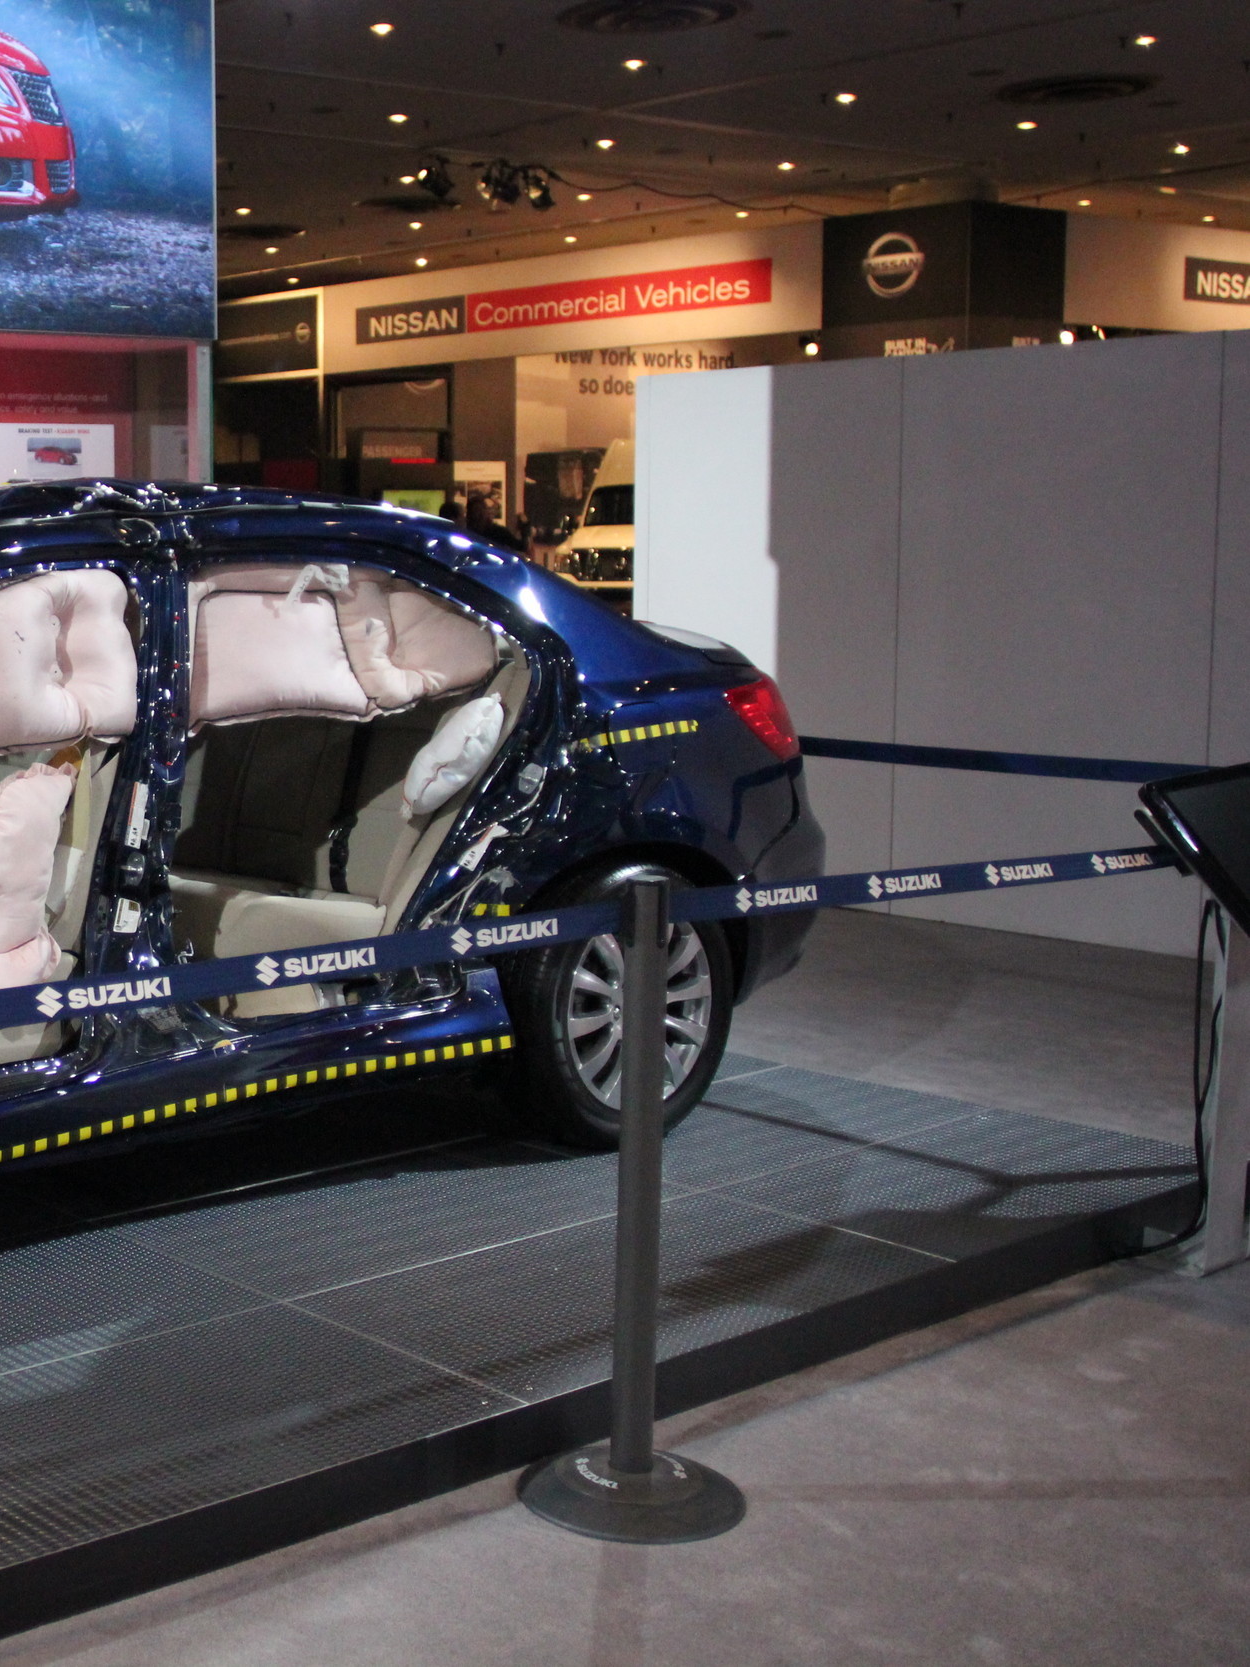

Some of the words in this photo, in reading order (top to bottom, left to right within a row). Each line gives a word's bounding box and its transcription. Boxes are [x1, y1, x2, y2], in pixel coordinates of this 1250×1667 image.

[1196, 270, 1250, 300] NISSA
[368, 307, 459, 338] NISSAN
[474, 287, 626, 328] Commercial
[634, 276, 752, 310] Vehicles
[555, 349, 593, 364] New
[599, 346, 637, 367] York
[642, 349, 693, 369] works
[579, 377, 599, 395] so
[603, 375, 636, 396] doe
[1001, 862, 1054, 882] SUZUKI
[1105, 851, 1151, 870] SUZUKI
[884, 872, 942, 894] SUZUKI
[755, 885, 818, 908] SUZUKI
[476, 917, 559, 948] SUZUKI
[283, 946, 376, 978] SUZUKI
[67, 976, 171, 1010] SUZUKI
